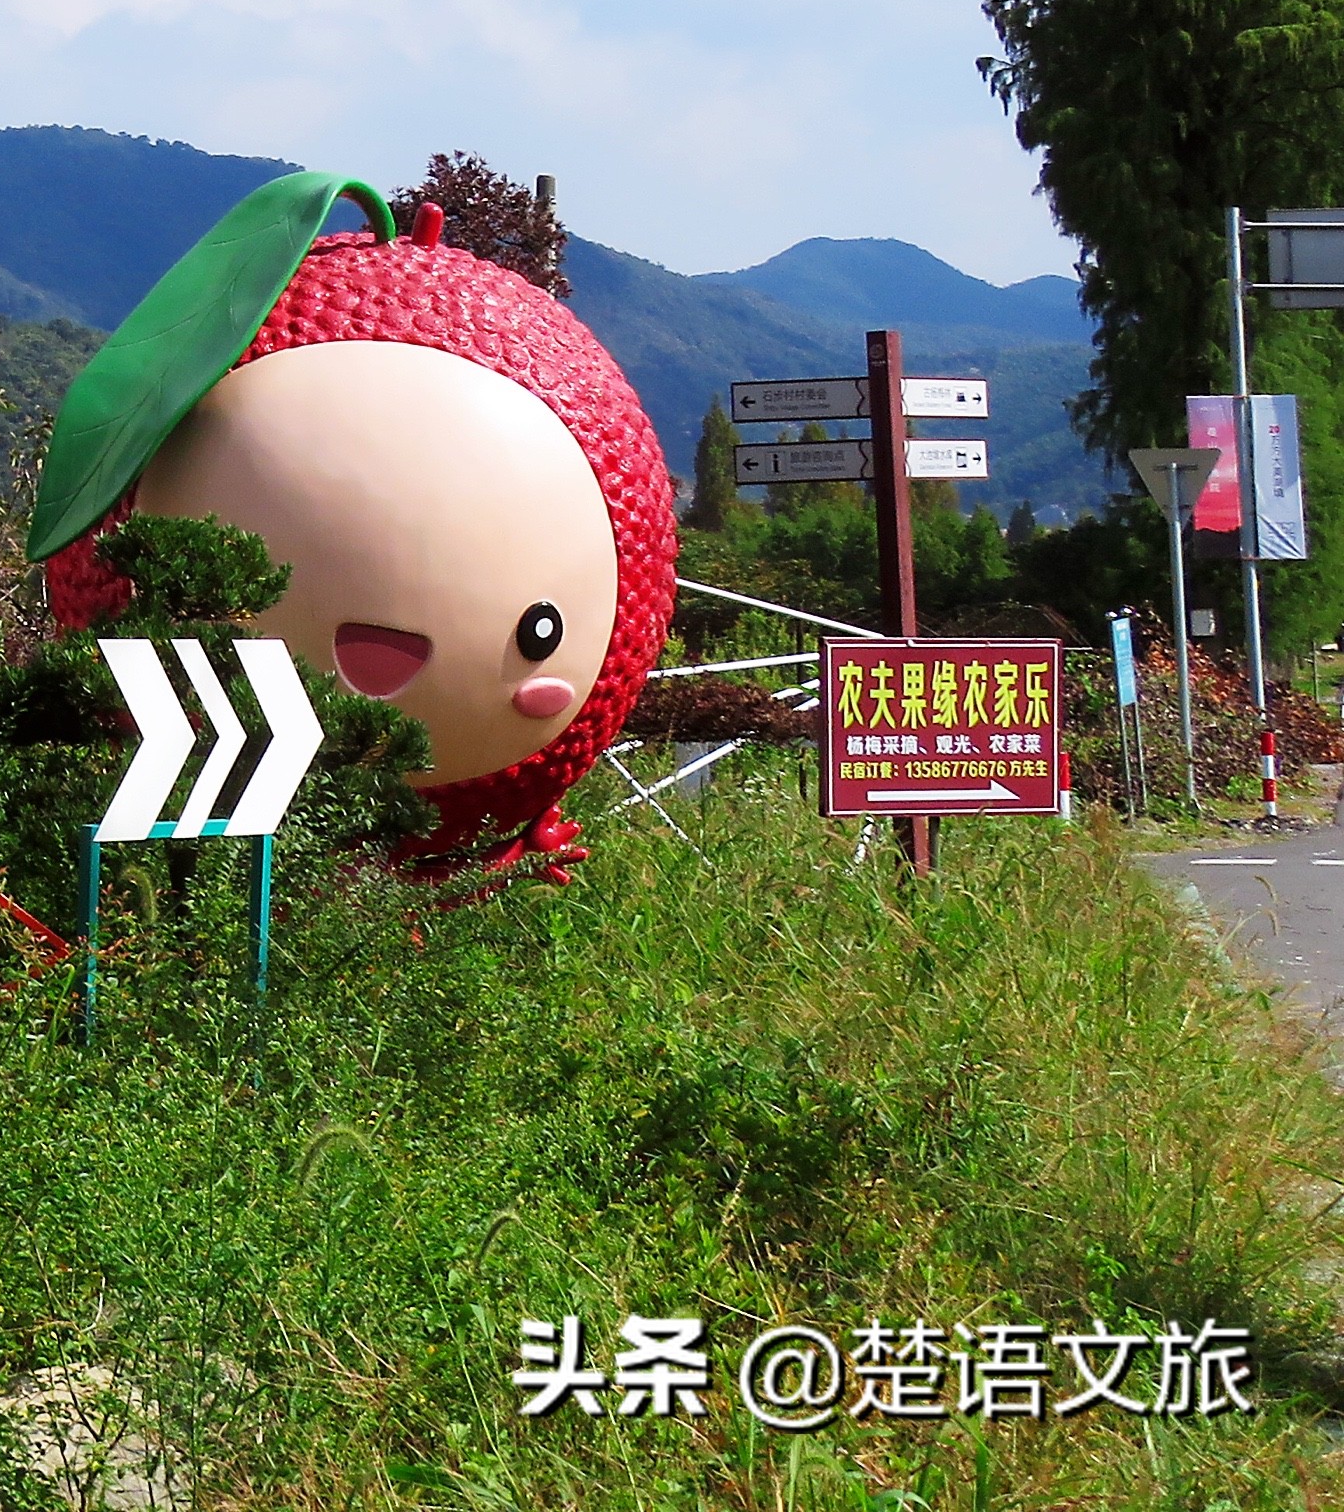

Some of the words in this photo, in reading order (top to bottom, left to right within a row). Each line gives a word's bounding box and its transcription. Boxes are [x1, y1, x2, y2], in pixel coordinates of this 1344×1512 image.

[838, 660, 1050, 729] 农夫果缘农家乐
[846, 734, 1042, 755] 杨梅采摘、观光、农家菜
